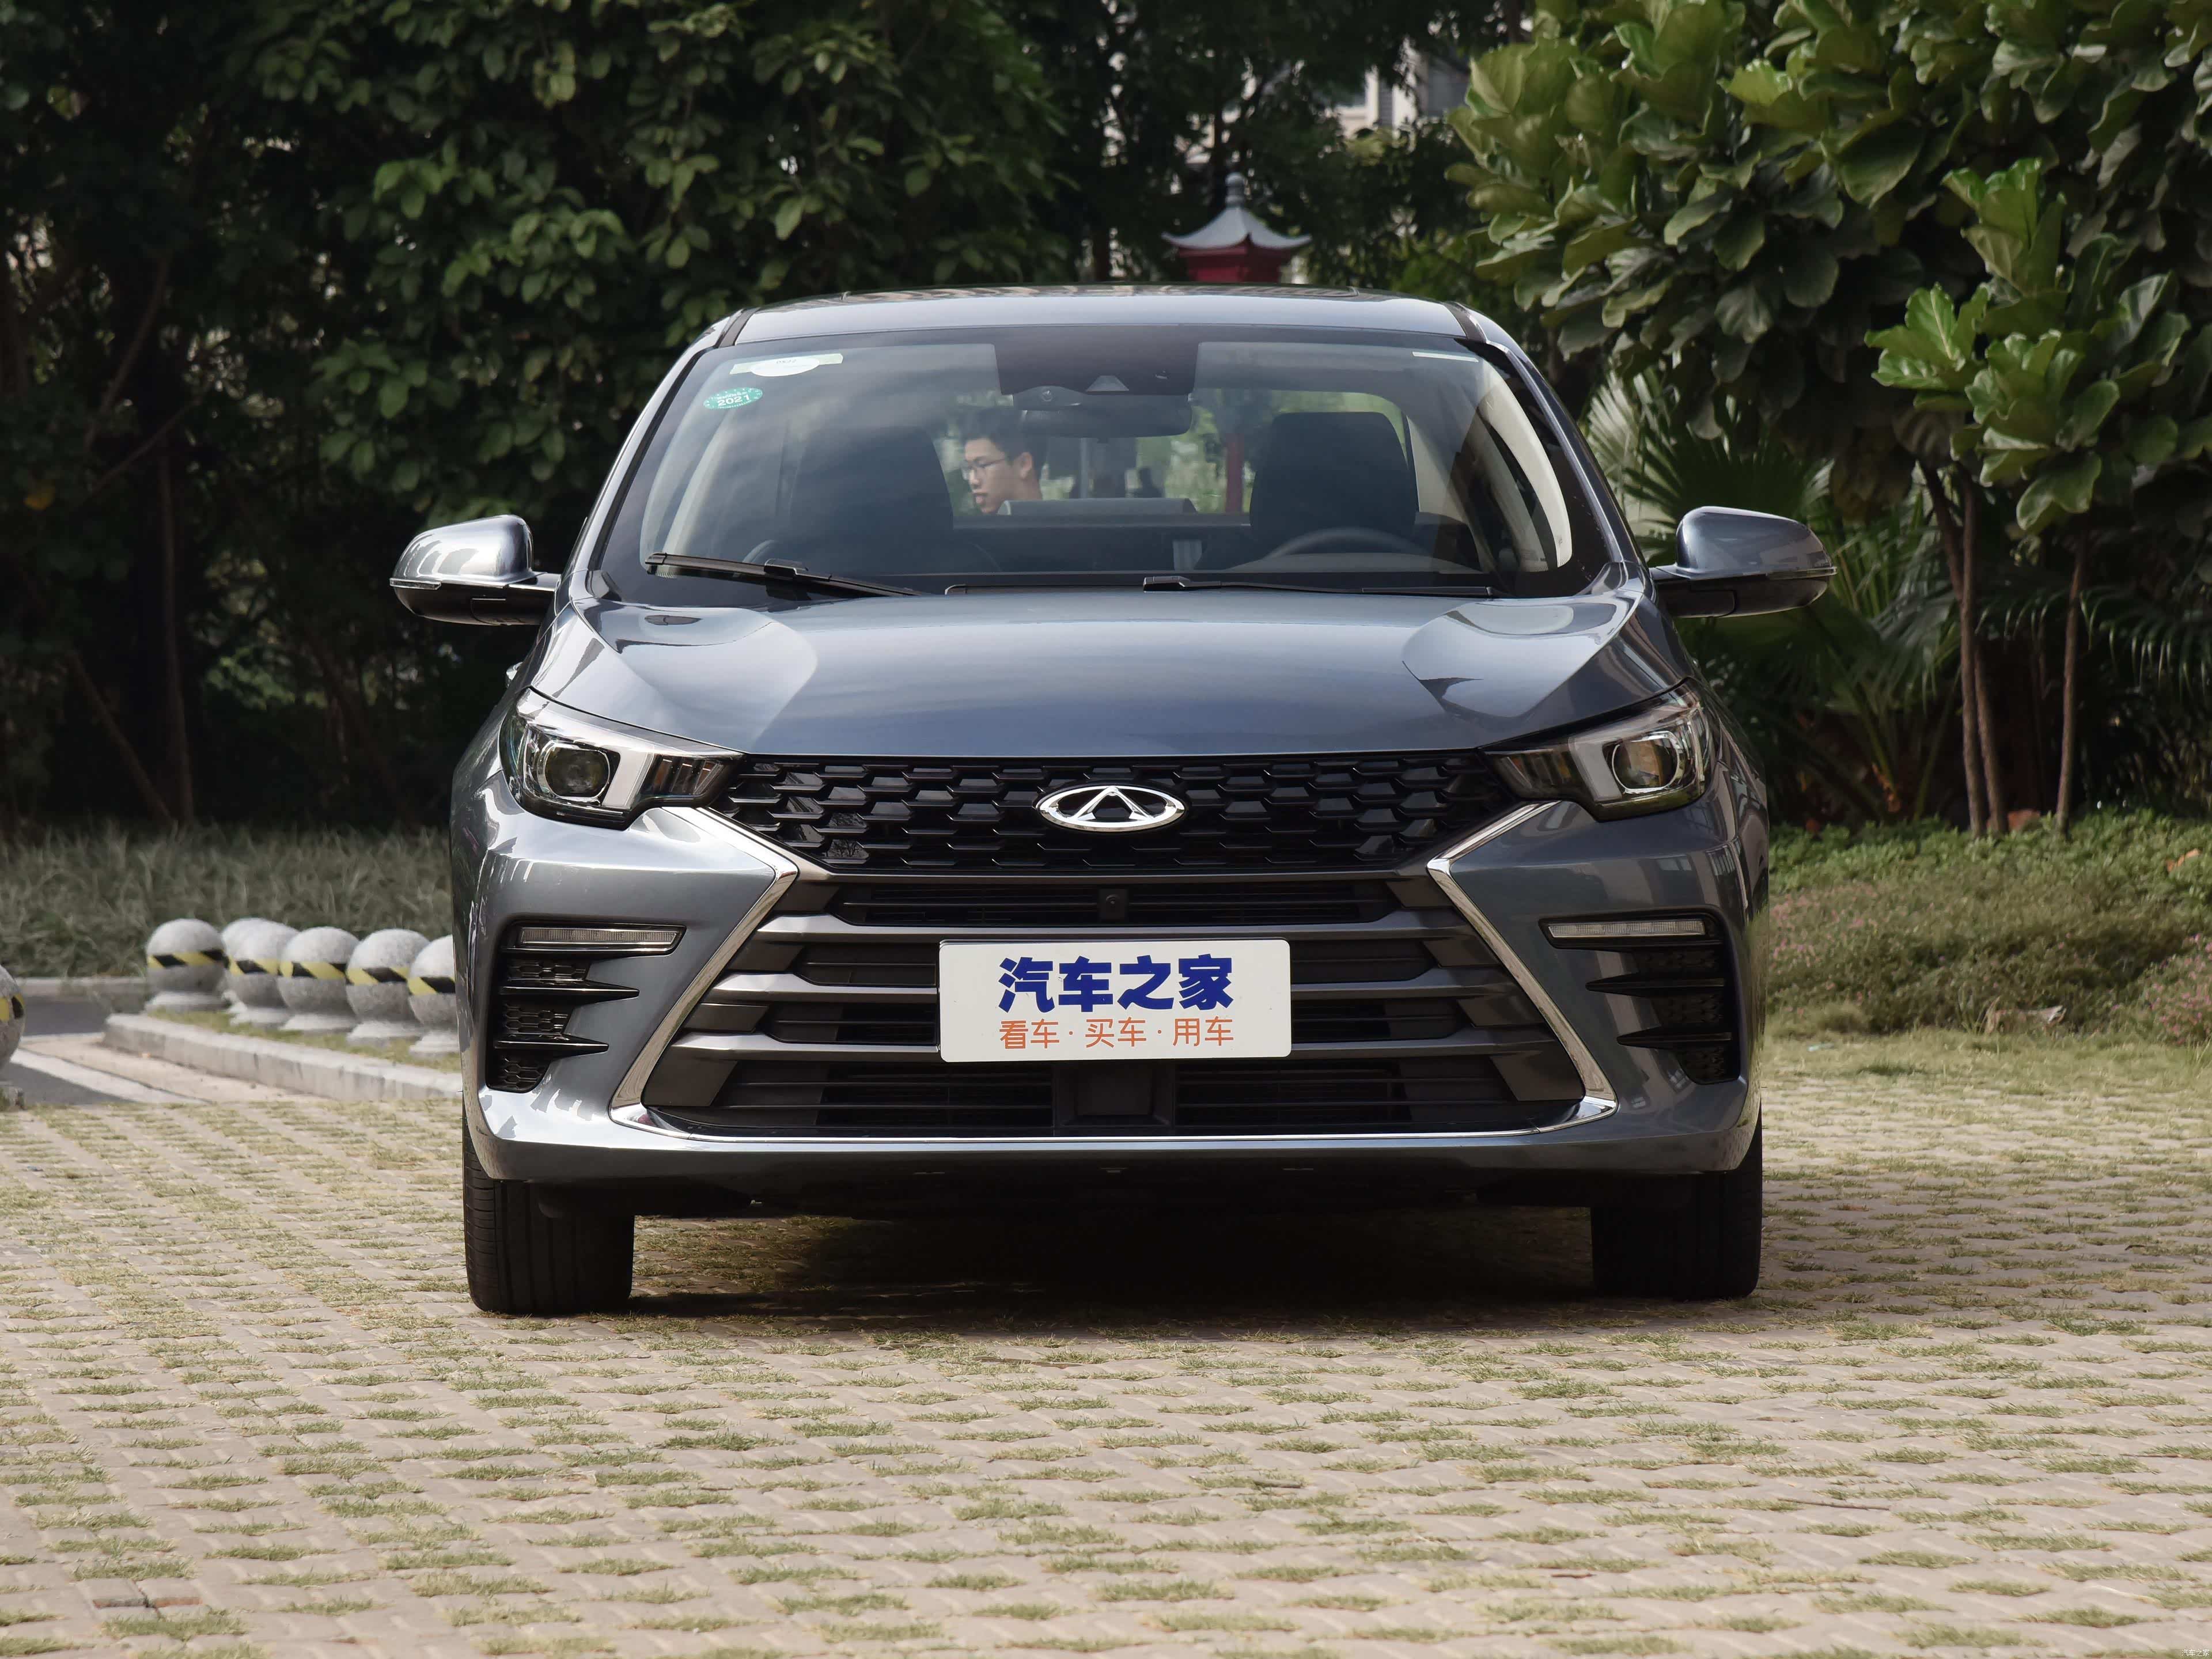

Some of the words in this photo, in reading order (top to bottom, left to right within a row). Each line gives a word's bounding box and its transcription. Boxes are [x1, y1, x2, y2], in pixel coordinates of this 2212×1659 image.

[718, 394, 749, 406] 2021
[998, 954, 1233, 1013] 汽车之家
